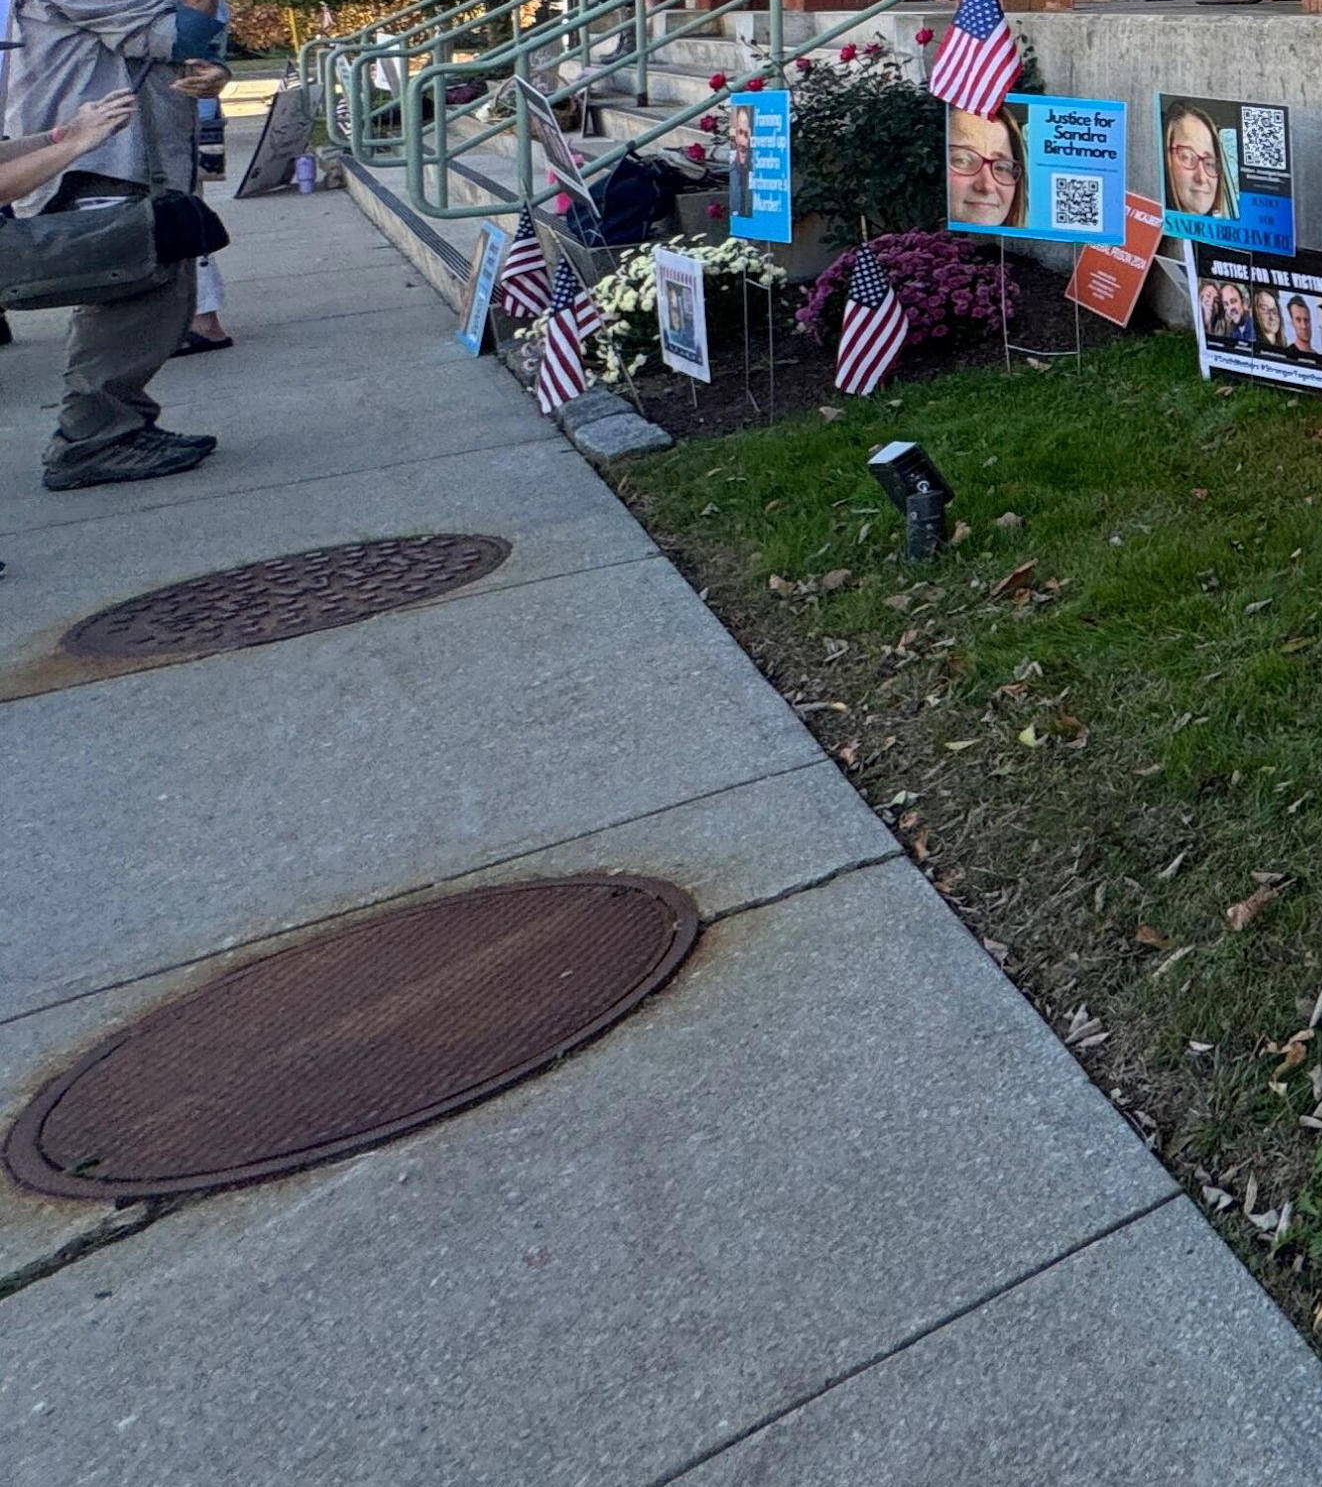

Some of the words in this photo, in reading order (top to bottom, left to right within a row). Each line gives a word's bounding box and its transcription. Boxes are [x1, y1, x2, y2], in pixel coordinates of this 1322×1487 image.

[1045, 108, 1091, 126] Justice
[1094, 111, 1116, 128] for
[1053, 124, 1107, 143] Sandra
[1044, 139, 1117, 160] Birchmore
[1165, 215, 1215, 240] SANDRA
[1216, 225, 1294, 250] BIRCHMORE
[1211, 260, 1249, 281] JUSTICE
[1250, 266, 1270, 284] FOR
[1270, 269, 1291, 287] THE
